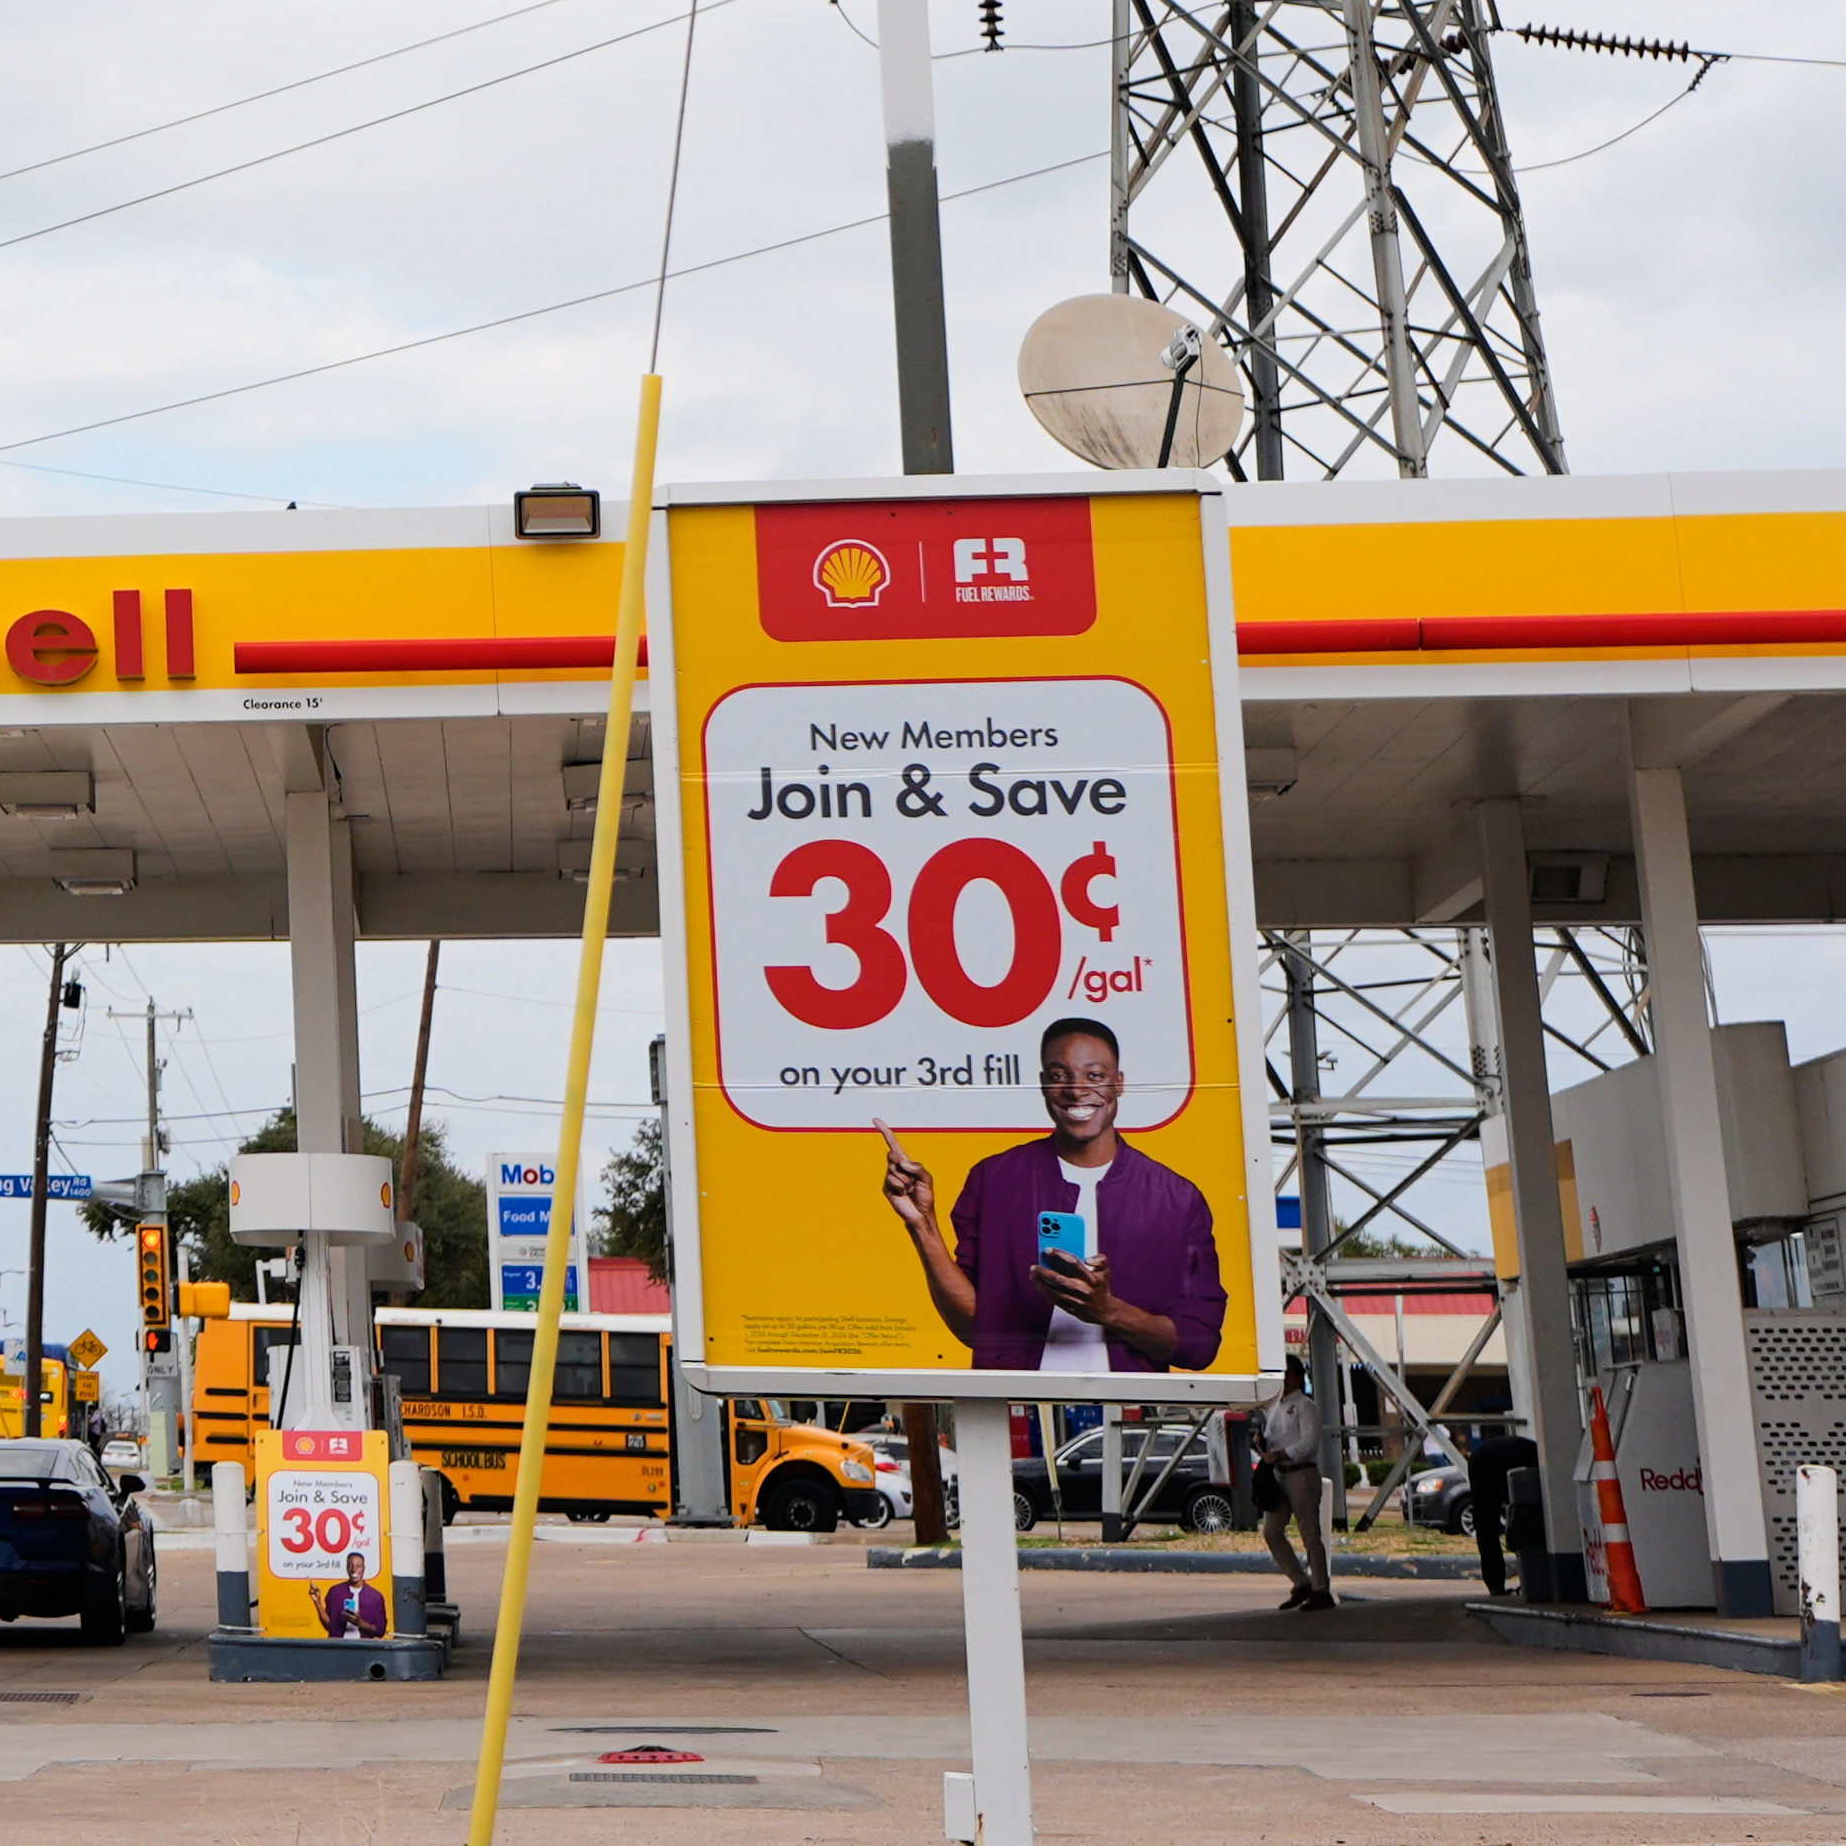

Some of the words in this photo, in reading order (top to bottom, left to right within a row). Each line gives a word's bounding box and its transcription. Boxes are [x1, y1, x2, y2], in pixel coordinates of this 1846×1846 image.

[956, 586, 980, 603] FUEL
[243, 698, 302, 710] Clearance
[810, 724, 890, 752] New
[900, 717, 1059, 750] Members
[746, 764, 873, 820] Join
[895, 762, 949, 818] &
[968, 762, 1127, 817] Save
[778, 1065, 821, 1086] on
[831, 1063, 907, 1094] your
[916, 1054, 974, 1087] 3rd
[983, 1054, 1021, 1086] fill
[500, 1164, 555, 1185] Mob
[18, 1176, 73, 1196] Vley
[72, 1177, 87, 1187] Rd
[503, 1210, 536, 1223] Food
[147, 1365, 174, 1374] ONLY
[402, 1404, 450, 1418] HARDSON
[441, 1452, 483, 1468] SCHOOL
[484, 1453, 506, 1469] BUS
[292, 1479, 313, 1488] New
[314, 1479, 353, 1489] Members
[277, 1489, 309, 1504] Join
[313, 1490, 326, 1504] &
[330, 1490, 368, 1505] Save
[296, 1561, 315, 1570] your
[316, 1560, 330, 1569] 3rd
[331, 1559, 341, 1569] fill
